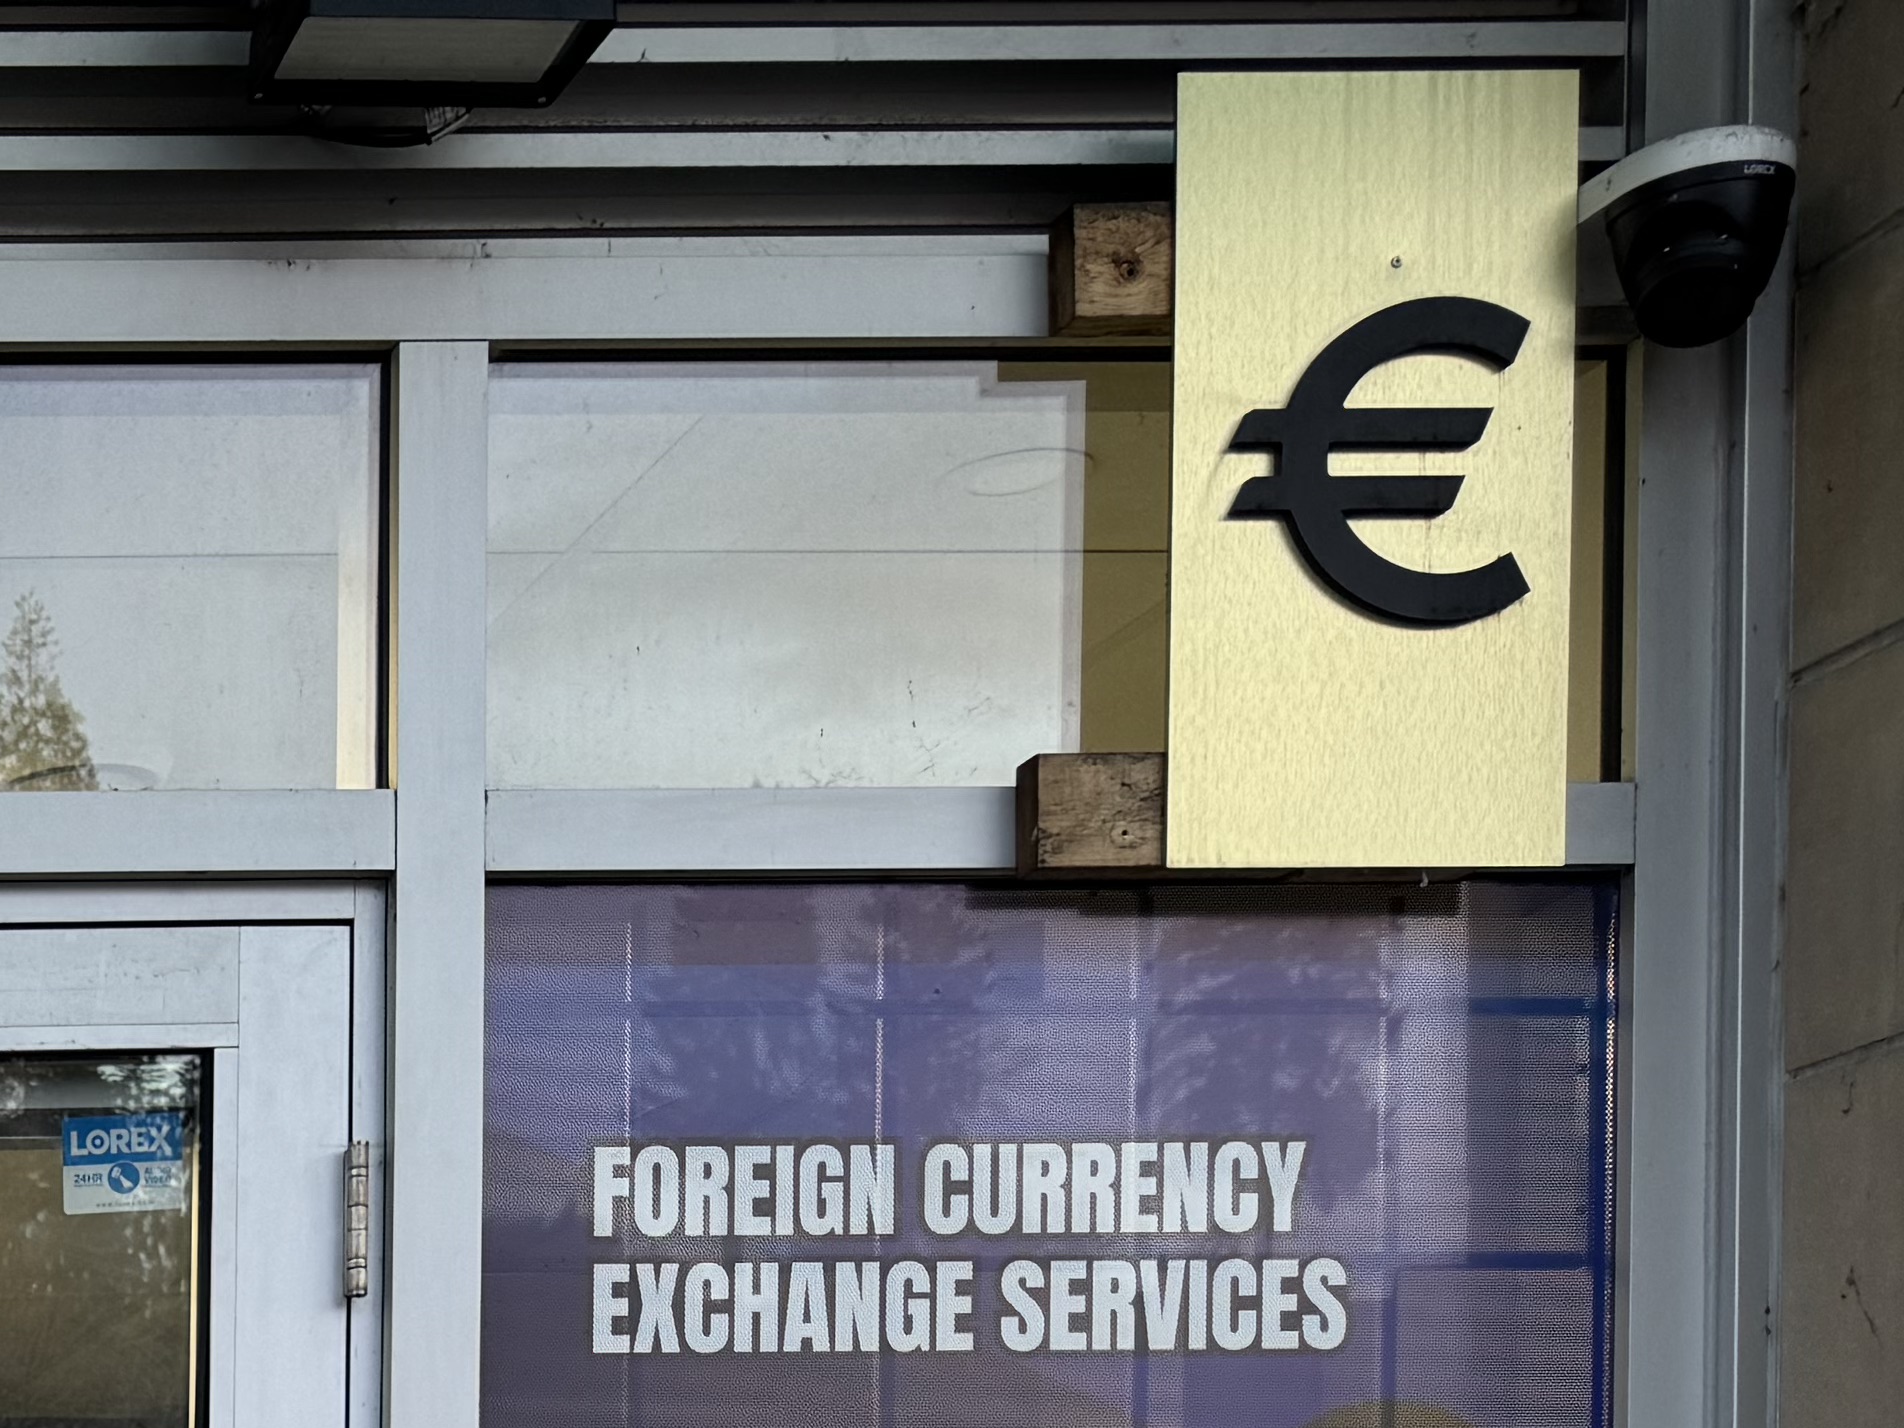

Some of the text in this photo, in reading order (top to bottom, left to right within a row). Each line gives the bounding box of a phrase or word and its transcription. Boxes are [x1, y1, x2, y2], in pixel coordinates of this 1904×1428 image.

[69, 1125, 172, 1156] LOREX
[593, 1141, 1305, 1236] FOREIGN CURRENCY
[593, 1258, 1348, 1353] EXCHANGE SERVICES
